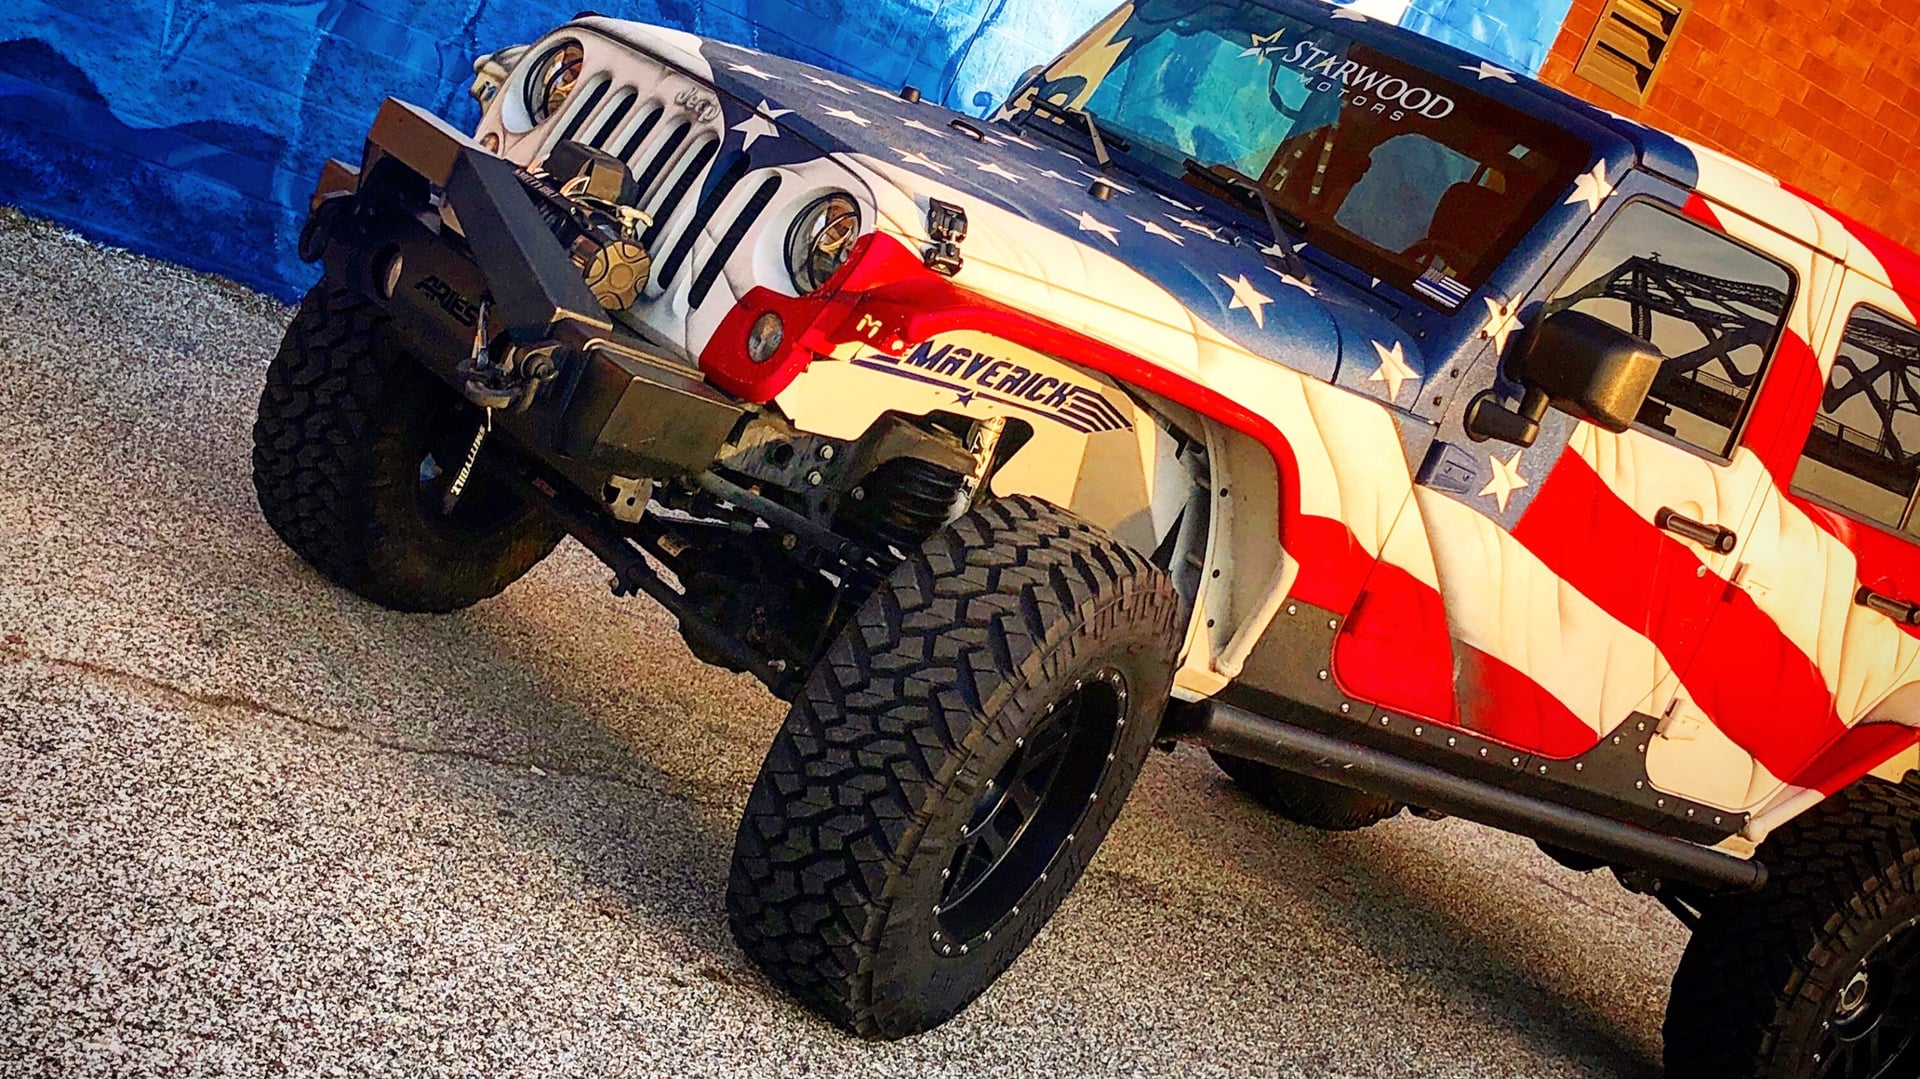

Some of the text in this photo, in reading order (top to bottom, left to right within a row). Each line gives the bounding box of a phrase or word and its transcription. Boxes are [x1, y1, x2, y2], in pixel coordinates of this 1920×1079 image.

[674, 87, 721, 123] Jeep
[1282, 40, 1455, 120] STARWOOD
[1296, 73, 1405, 122] MOTORS
[414, 274, 481, 328] ARIES
[904, 339, 1074, 410] MAVERICK
